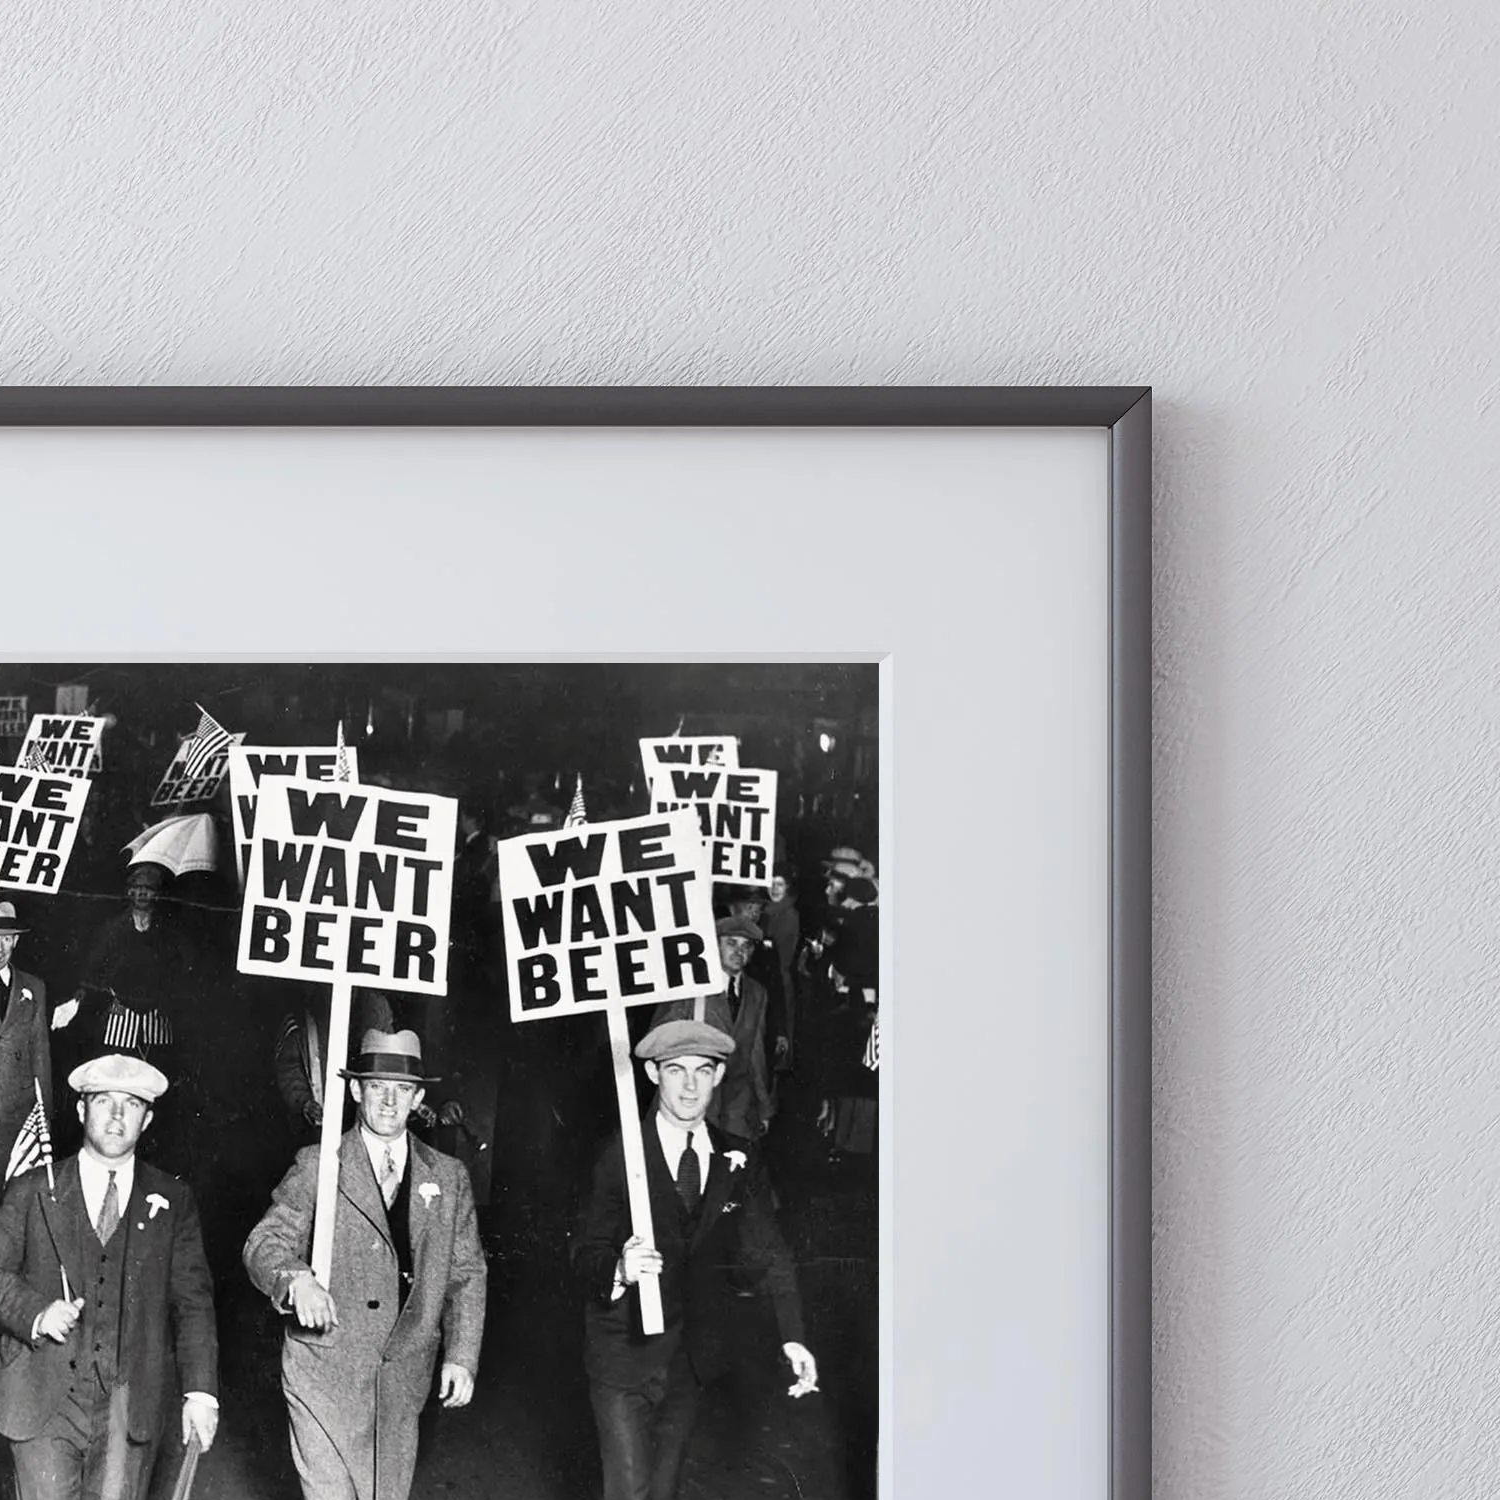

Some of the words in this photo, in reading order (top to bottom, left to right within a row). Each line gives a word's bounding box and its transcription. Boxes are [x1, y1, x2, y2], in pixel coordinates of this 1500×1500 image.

[40, 719, 95, 741] WE
[653, 744, 726, 767] WE
[154, 777, 220, 801] BEER
[246, 754, 338, 789] WE
[670, 770, 760, 803] WE
[287, 787, 430, 852] WE
[262, 838, 443, 917] WANT
[526, 823, 676, 888] WE
[512, 871, 696, 950] WANT
[249, 904, 437, 983] BEER
[517, 933, 711, 1011] BEER
